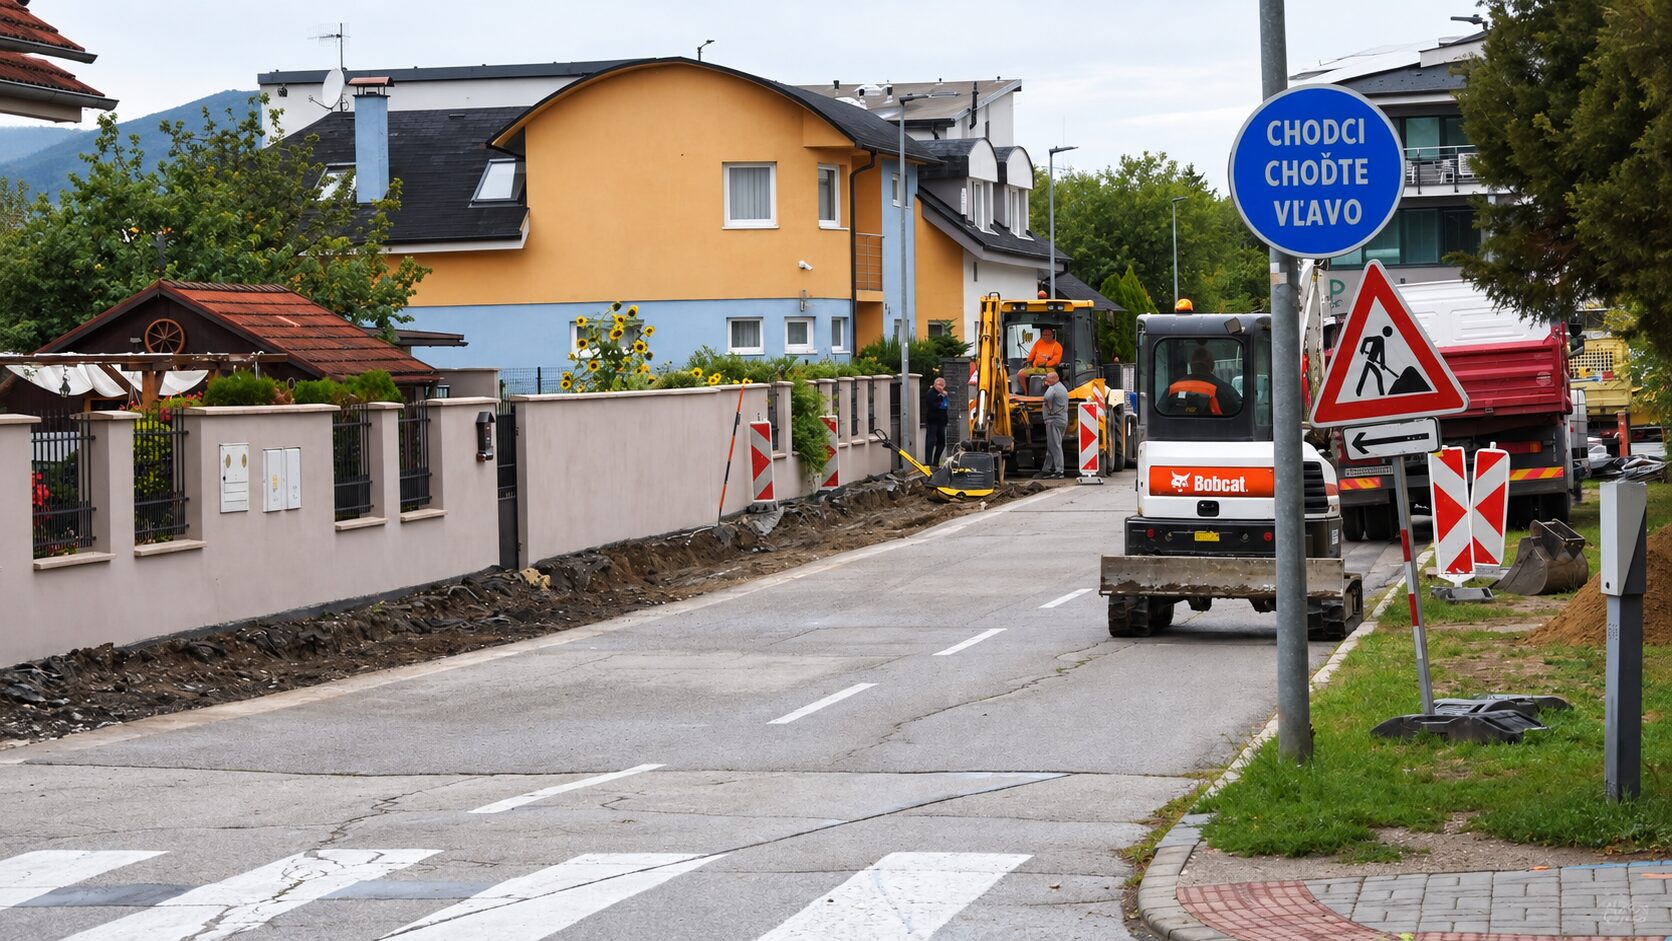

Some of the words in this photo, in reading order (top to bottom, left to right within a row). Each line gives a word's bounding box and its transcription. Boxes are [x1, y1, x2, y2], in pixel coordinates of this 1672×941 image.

[1266, 118, 1365, 146] CHODCI
[1264, 152, 1369, 187] CHOĎTE
[1273, 198, 1363, 227] VĽAVO
